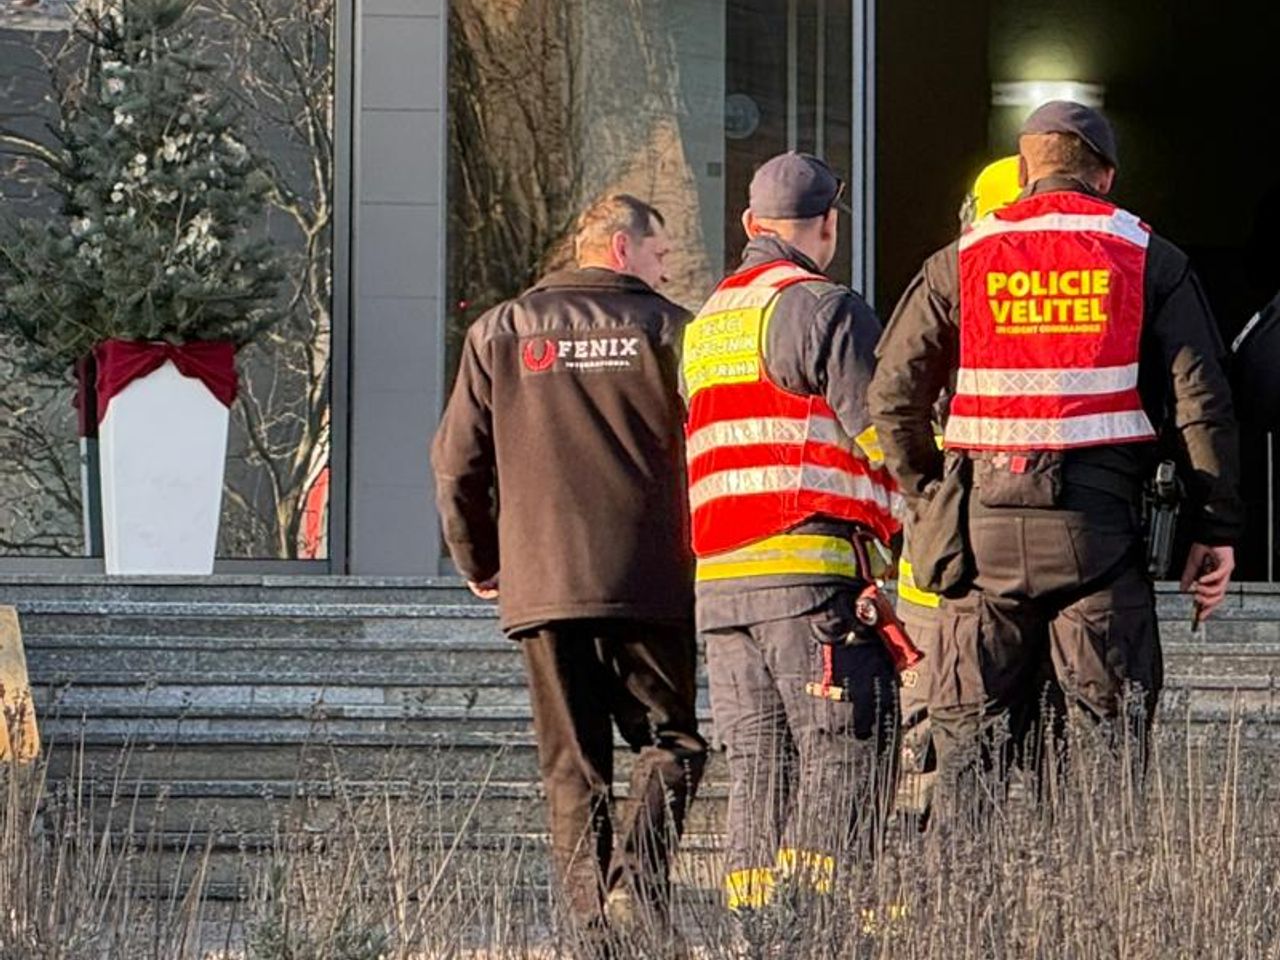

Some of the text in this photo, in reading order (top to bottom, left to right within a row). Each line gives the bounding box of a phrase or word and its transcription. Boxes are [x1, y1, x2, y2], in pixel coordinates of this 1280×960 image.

[986, 269, 1111, 297] POLICIE
[988, 298, 1108, 324] VELITEL
[557, 337, 640, 359] FENIX
